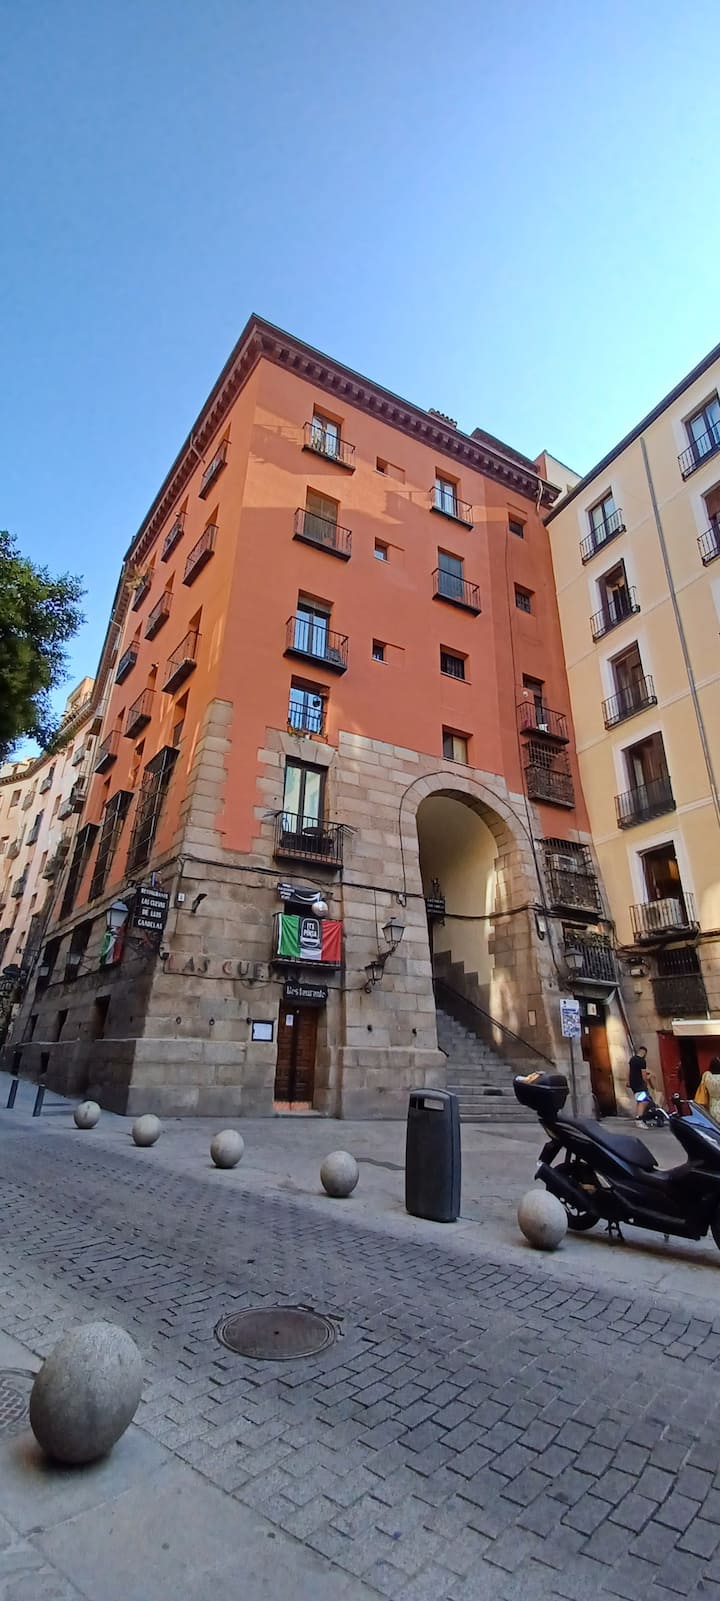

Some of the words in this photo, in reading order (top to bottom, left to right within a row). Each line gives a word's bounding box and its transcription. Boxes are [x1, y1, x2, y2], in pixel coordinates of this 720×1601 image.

[141, 898, 150, 906] LAS
[137, 919, 163, 930] CANDELAS
[168, 955, 210, 974] LAS
